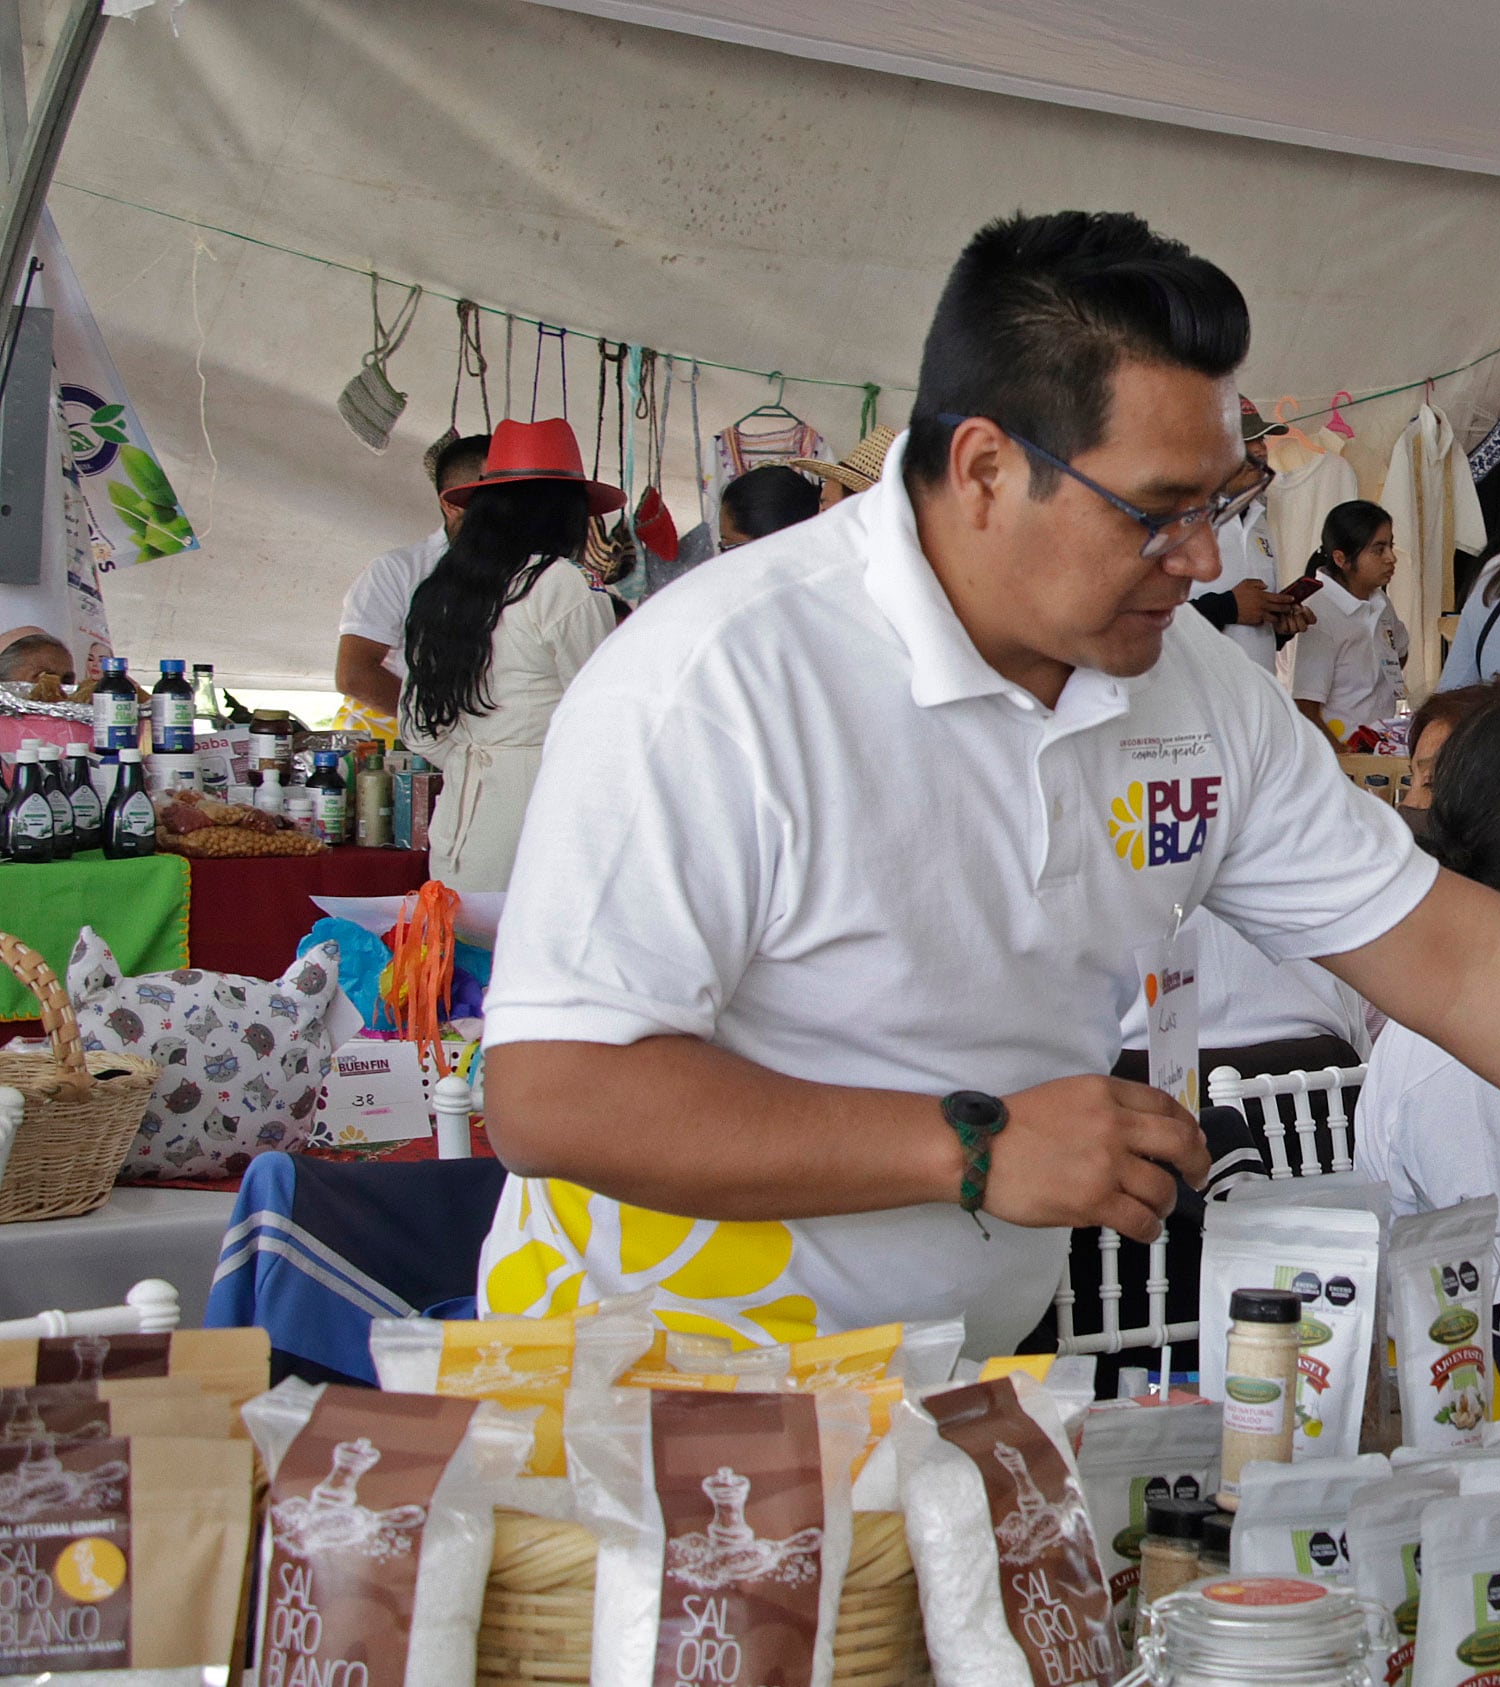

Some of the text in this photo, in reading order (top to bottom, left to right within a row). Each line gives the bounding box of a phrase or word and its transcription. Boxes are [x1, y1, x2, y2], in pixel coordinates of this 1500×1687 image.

[1132, 750, 1157, 760] como
[1172, 741, 1206, 765] gente
[1147, 776, 1222, 823] PUE
[1148, 819, 1207, 868] BLA
[339, 1058, 390, 1072] BUEN FIN
[351, 1093, 375, 1107] 38
[1297, 1359, 1325, 1377] ASTA
[1435, 1358, 1453, 1376] AJO
[1452, 1350, 1464, 1366] EN
[0, 1541, 40, 1575] SAL
[0, 1572, 53, 1610] ORO
[276, 1562, 318, 1611] SAL
[1012, 1568, 1061, 1614] SAL
[0, 1606, 100, 1648] BLANCO
[272, 1605, 323, 1656] ORO
[680, 1594, 736, 1640] SAL
[1023, 1604, 1077, 1648] ORO
[676, 1638, 742, 1684] ORO
